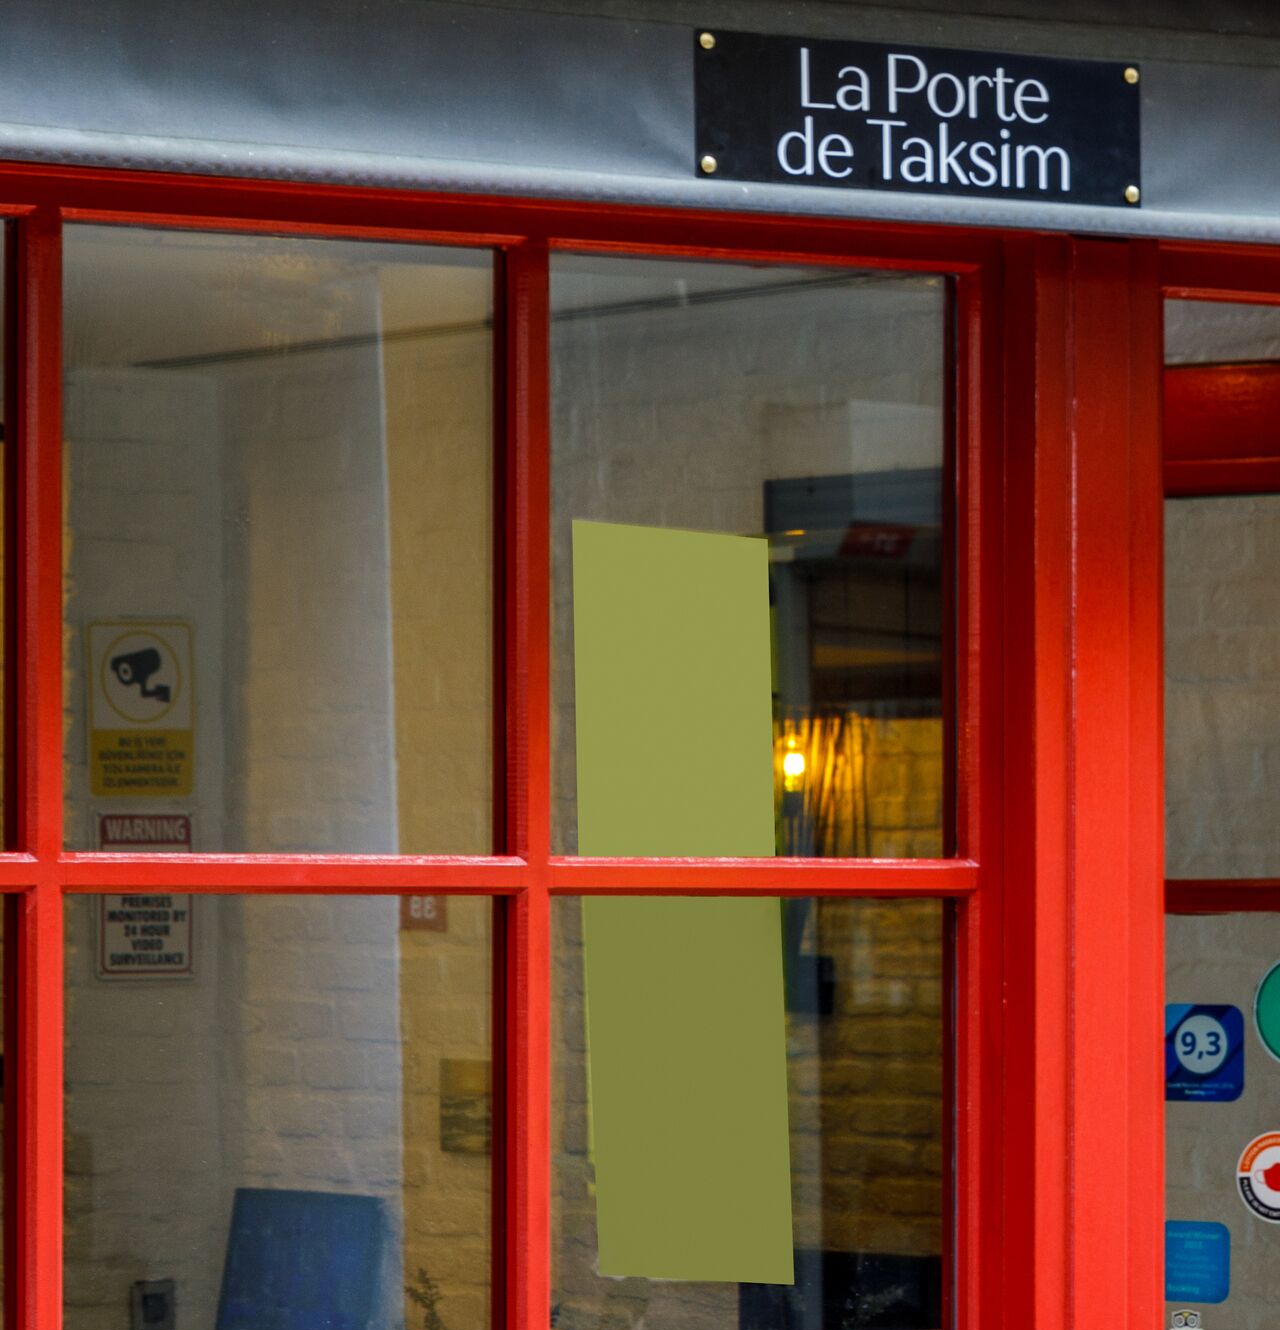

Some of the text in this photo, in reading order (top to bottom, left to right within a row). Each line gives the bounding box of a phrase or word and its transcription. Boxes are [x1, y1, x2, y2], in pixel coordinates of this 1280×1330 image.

[800, 47, 1050, 124] La Porte
[776, 115, 1071, 192] de Taksim
[105, 818, 186, 841] WARNING
[121, 895, 173, 908] PREMISES
[108, 909, 186, 922] MONITORED BY
[140, 925, 170, 937] HOUR
[131, 939, 164, 951] VIDEO
[110, 953, 184, 966] SURVEILLANCE
[1181, 1031, 1221, 1059] 9,3
